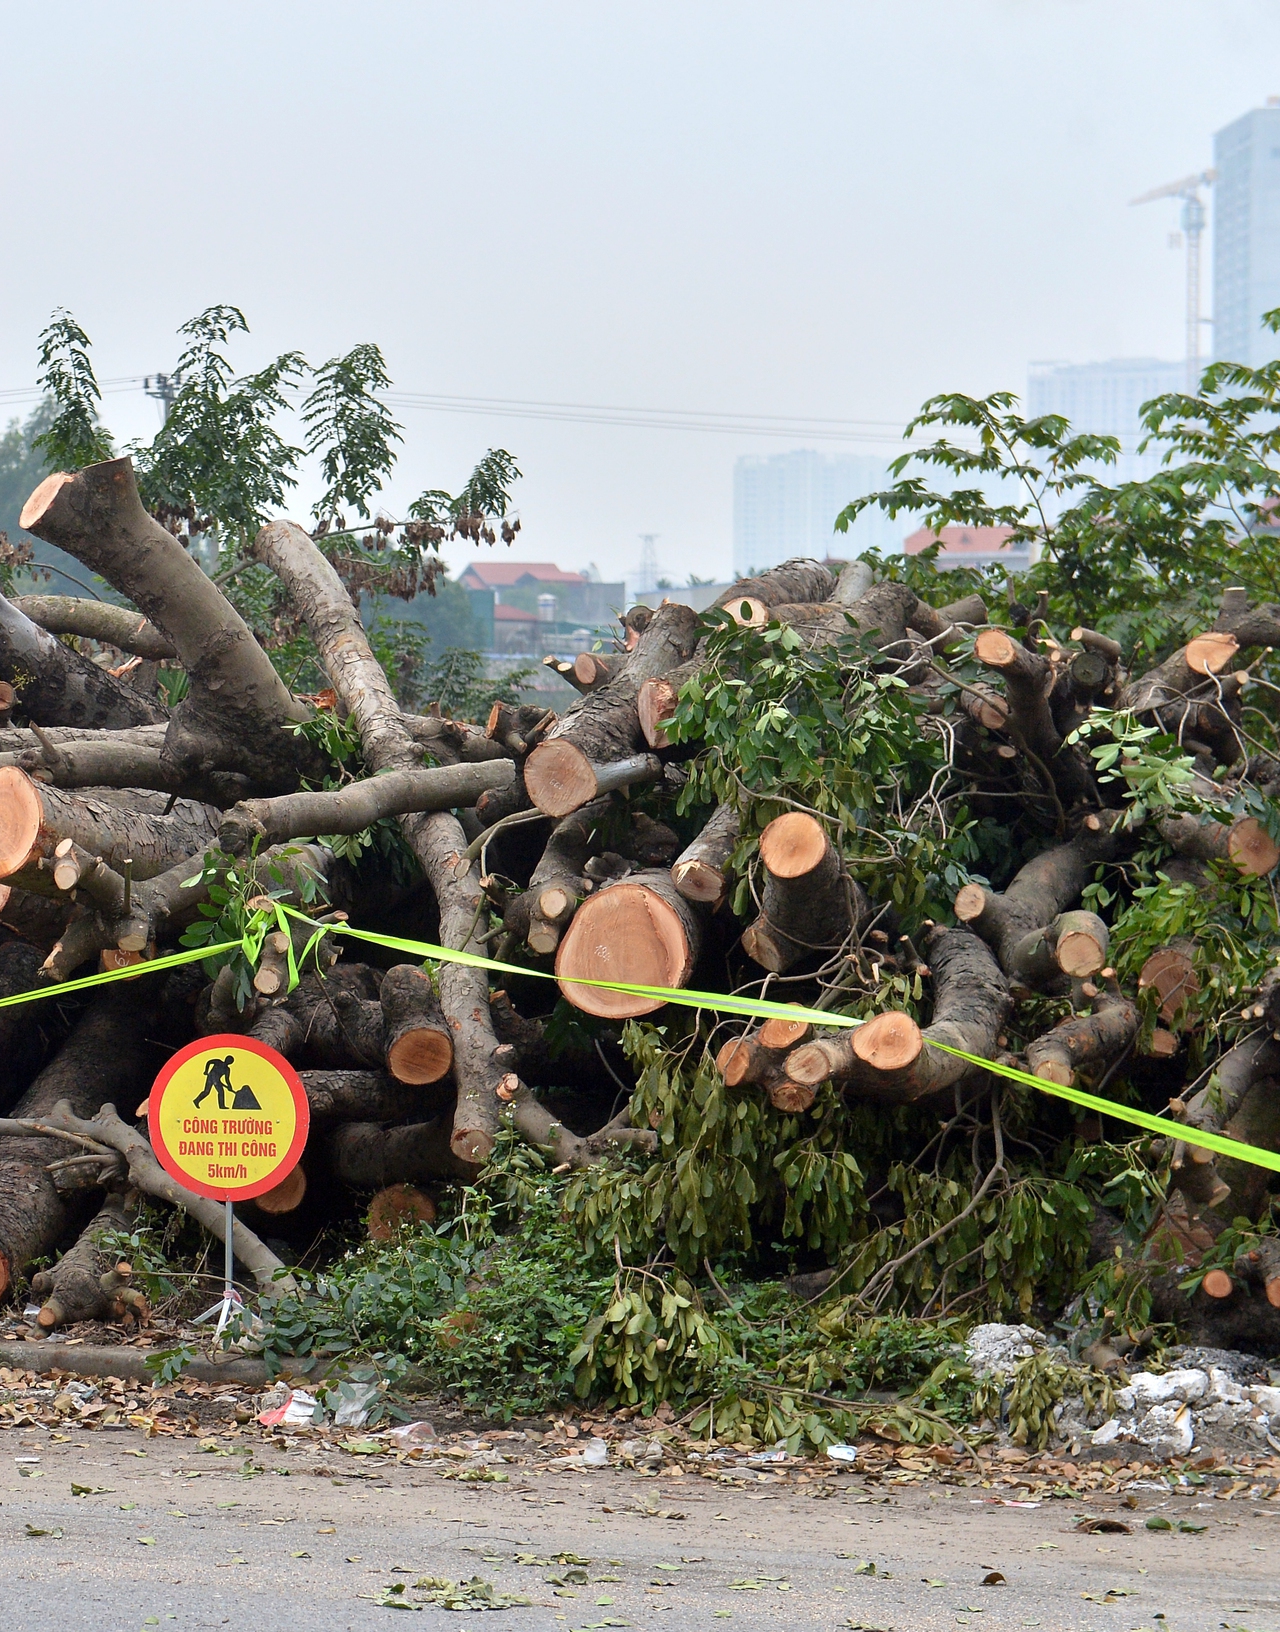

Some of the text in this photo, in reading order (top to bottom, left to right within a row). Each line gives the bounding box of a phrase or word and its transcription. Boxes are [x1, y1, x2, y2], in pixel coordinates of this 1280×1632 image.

[183, 1116, 273, 1135] CÔNG TRƯỜNG
[179, 1140, 277, 1157] ĐANG THI CÔNG
[208, 1164, 247, 1178] 5km/h
